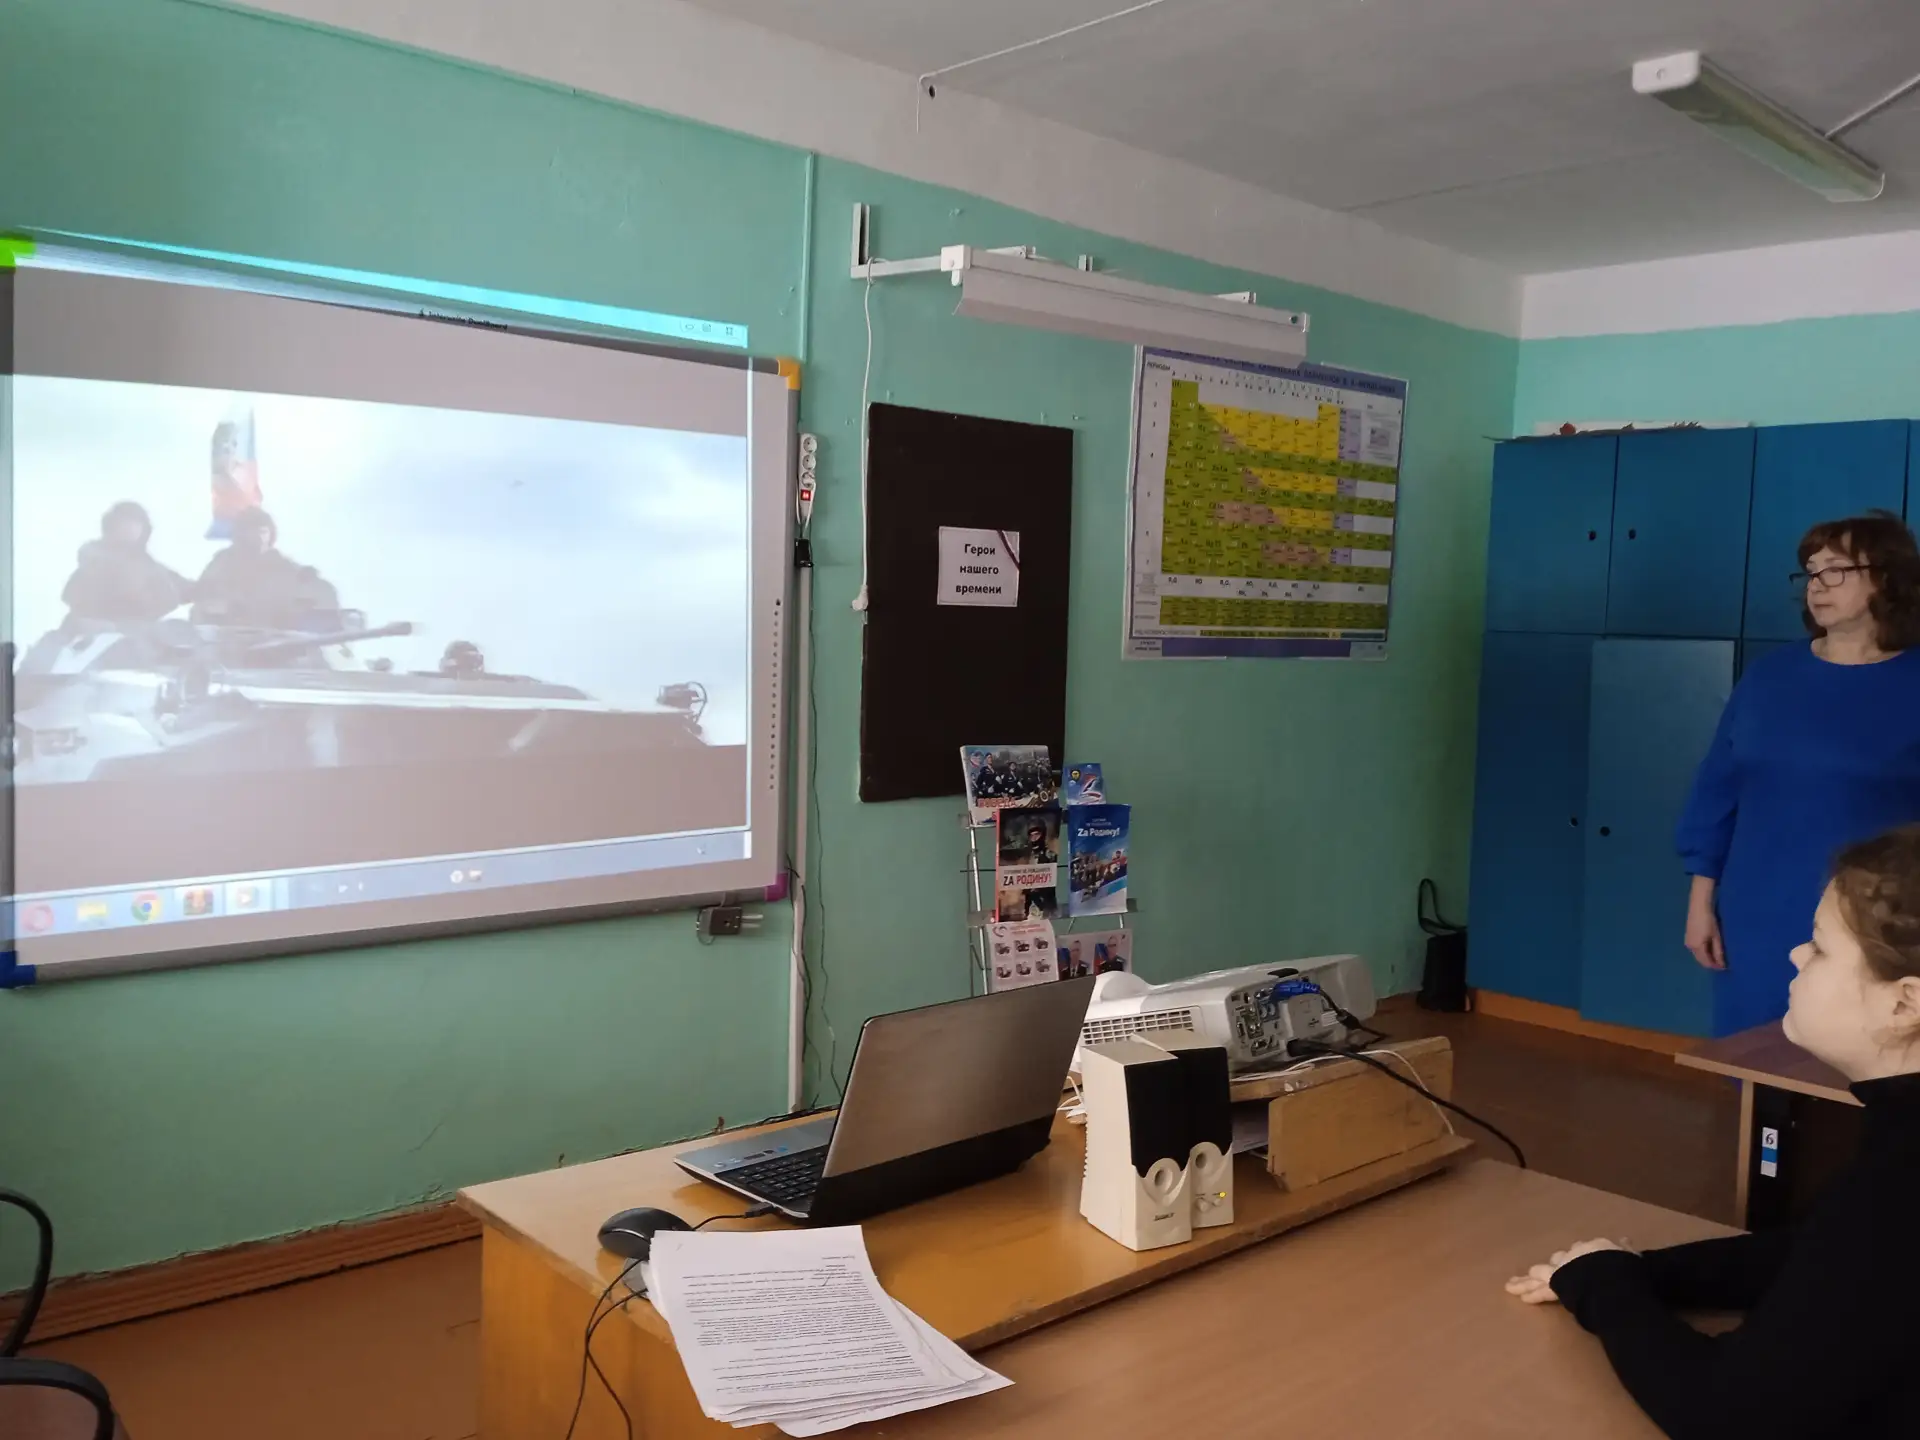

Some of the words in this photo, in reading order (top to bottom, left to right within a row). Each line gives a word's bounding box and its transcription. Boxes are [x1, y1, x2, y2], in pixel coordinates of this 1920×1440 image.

[964, 543, 996, 556] Герои
[959, 565, 999, 575] нашего
[955, 584, 1002, 596] времени
[1077, 828, 1089, 837] Za
[1003, 875, 1014, 886] ZA
[1765, 1133, 1774, 1146] 6
